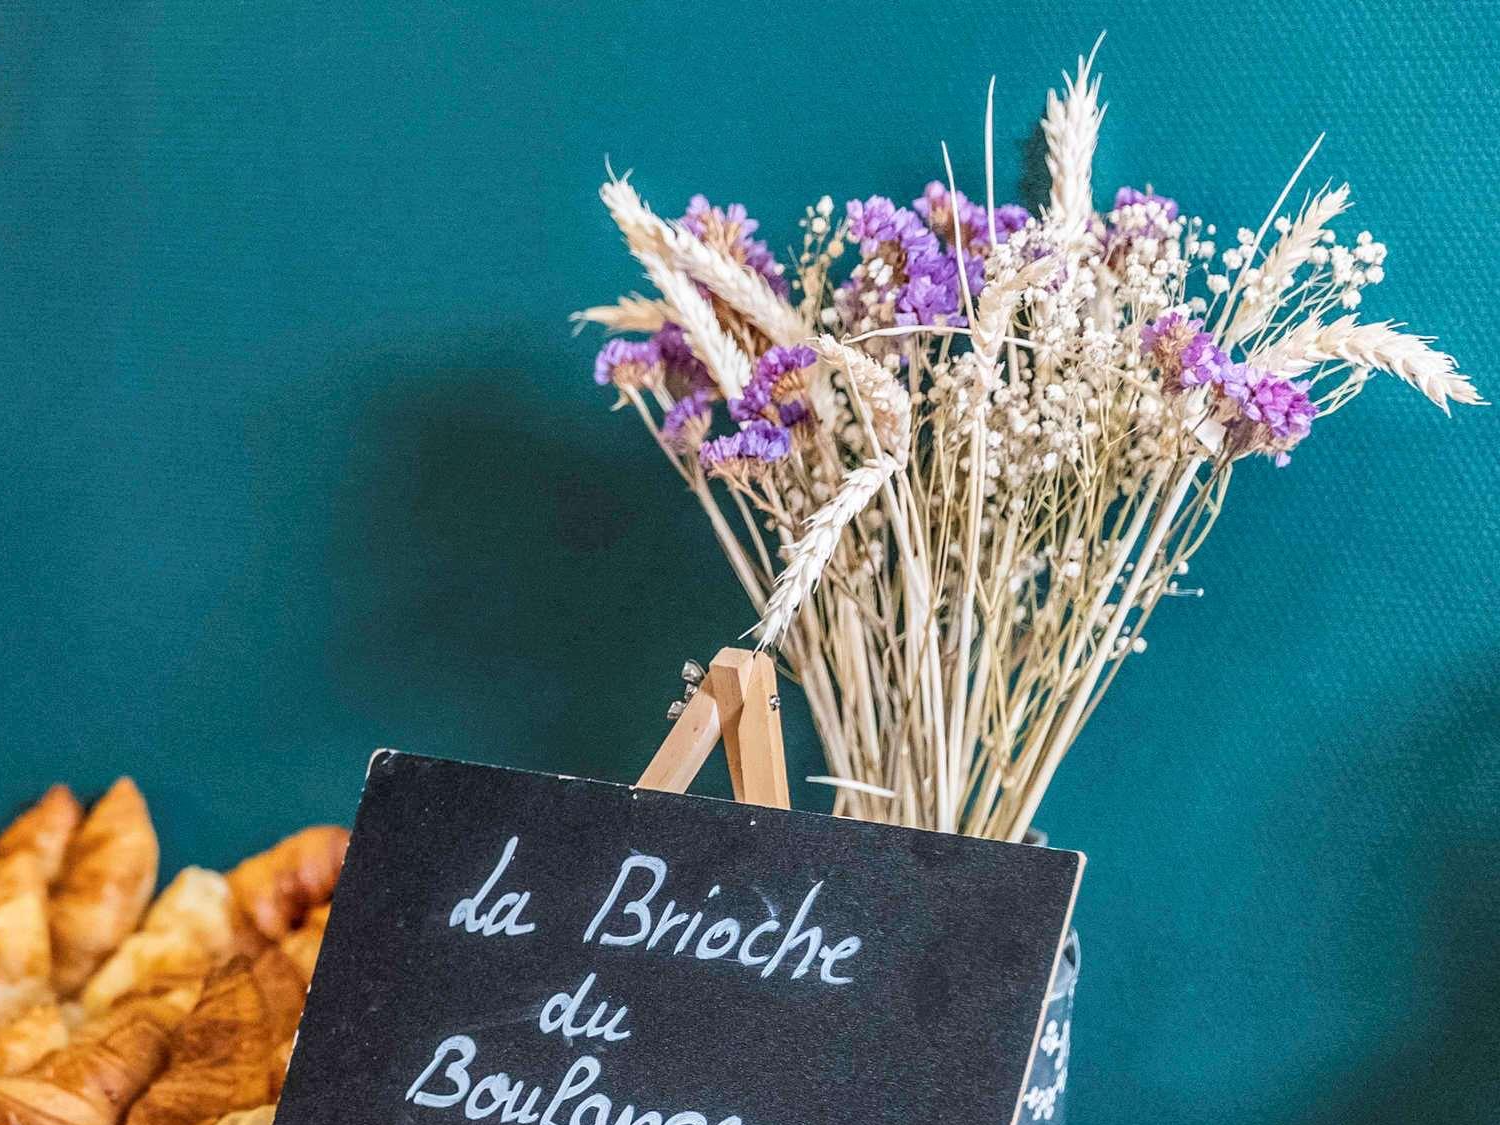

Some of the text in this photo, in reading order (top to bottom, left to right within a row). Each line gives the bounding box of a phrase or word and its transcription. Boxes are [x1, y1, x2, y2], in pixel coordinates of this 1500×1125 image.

[448, 836, 863, 986] La Brioche
[539, 972, 631, 1043] du
